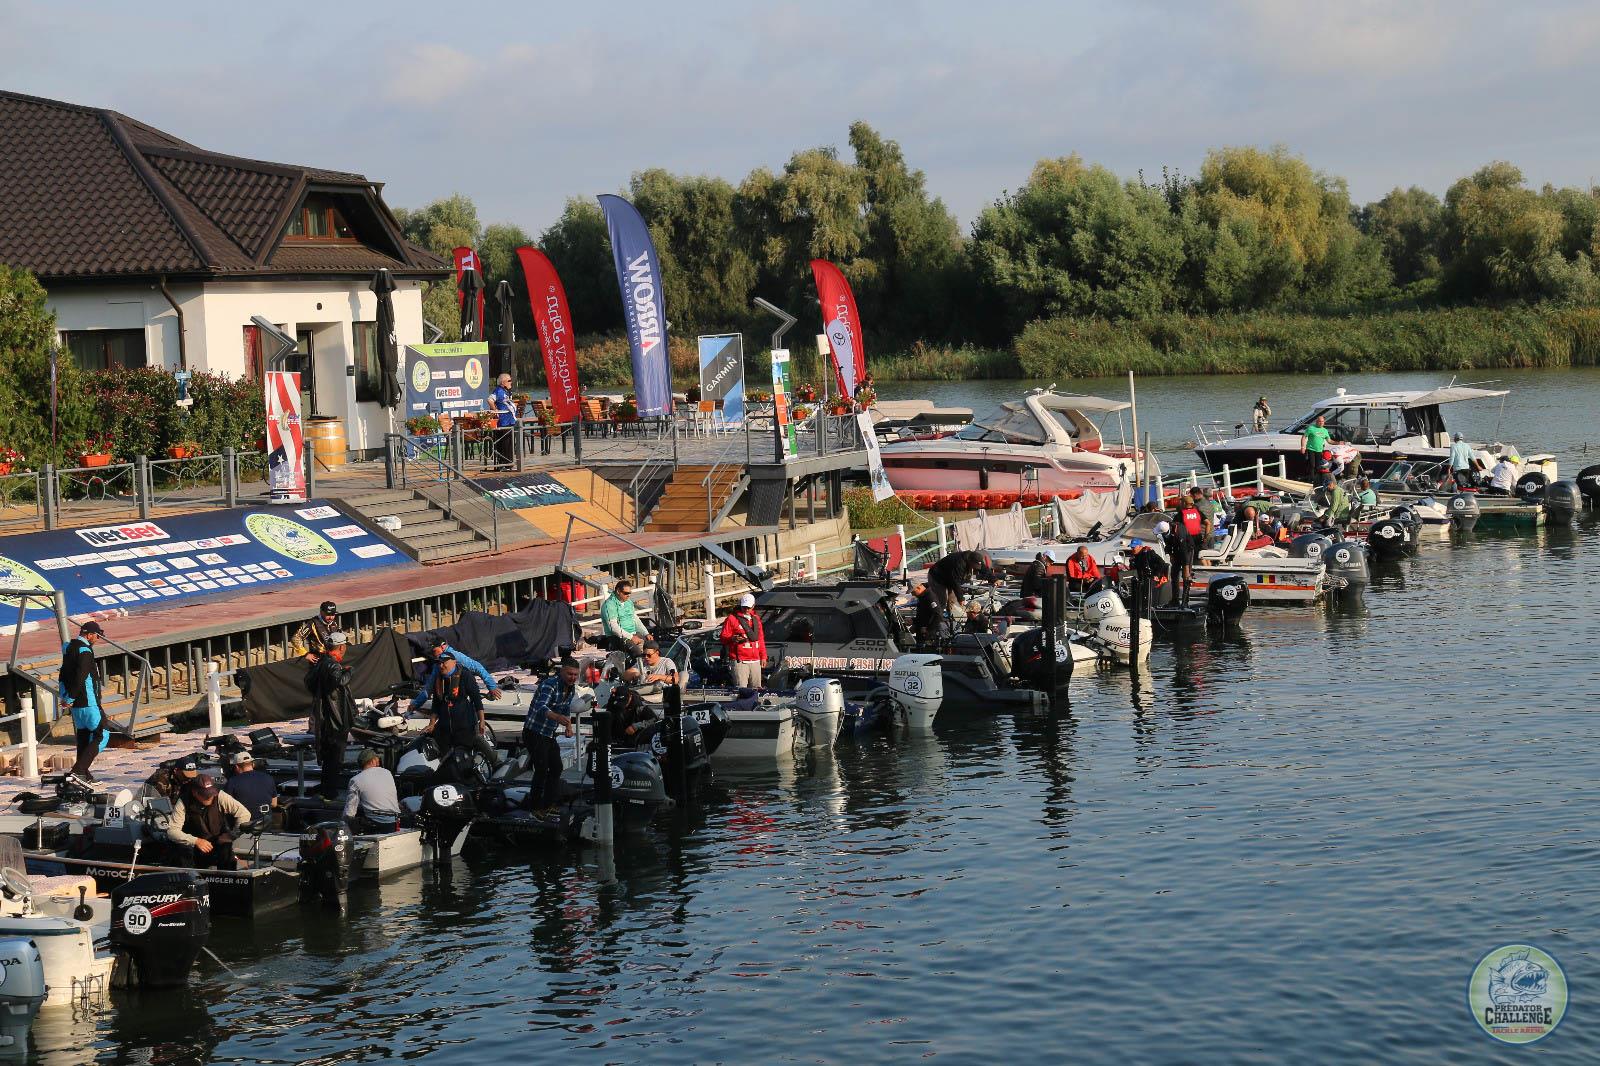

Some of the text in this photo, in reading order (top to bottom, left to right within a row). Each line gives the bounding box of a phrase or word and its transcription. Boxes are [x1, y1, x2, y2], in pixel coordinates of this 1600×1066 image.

[705, 358, 738, 392] GARMIN
[436, 388, 460, 397] NetBet
[81, 524, 165, 546] NetBet
[1224, 588, 1236, 597] 42
[1100, 601, 1111, 610] 40
[907, 681, 920, 690] 32
[809, 693, 821, 702] 30
[695, 711, 706, 721] 32
[441, 790, 450, 800] 8
[108, 806, 121, 819] 35
[205, 876, 234, 884] ANGLER
[118, 893, 183, 909] MERCURY
[128, 914, 147, 926] 90
